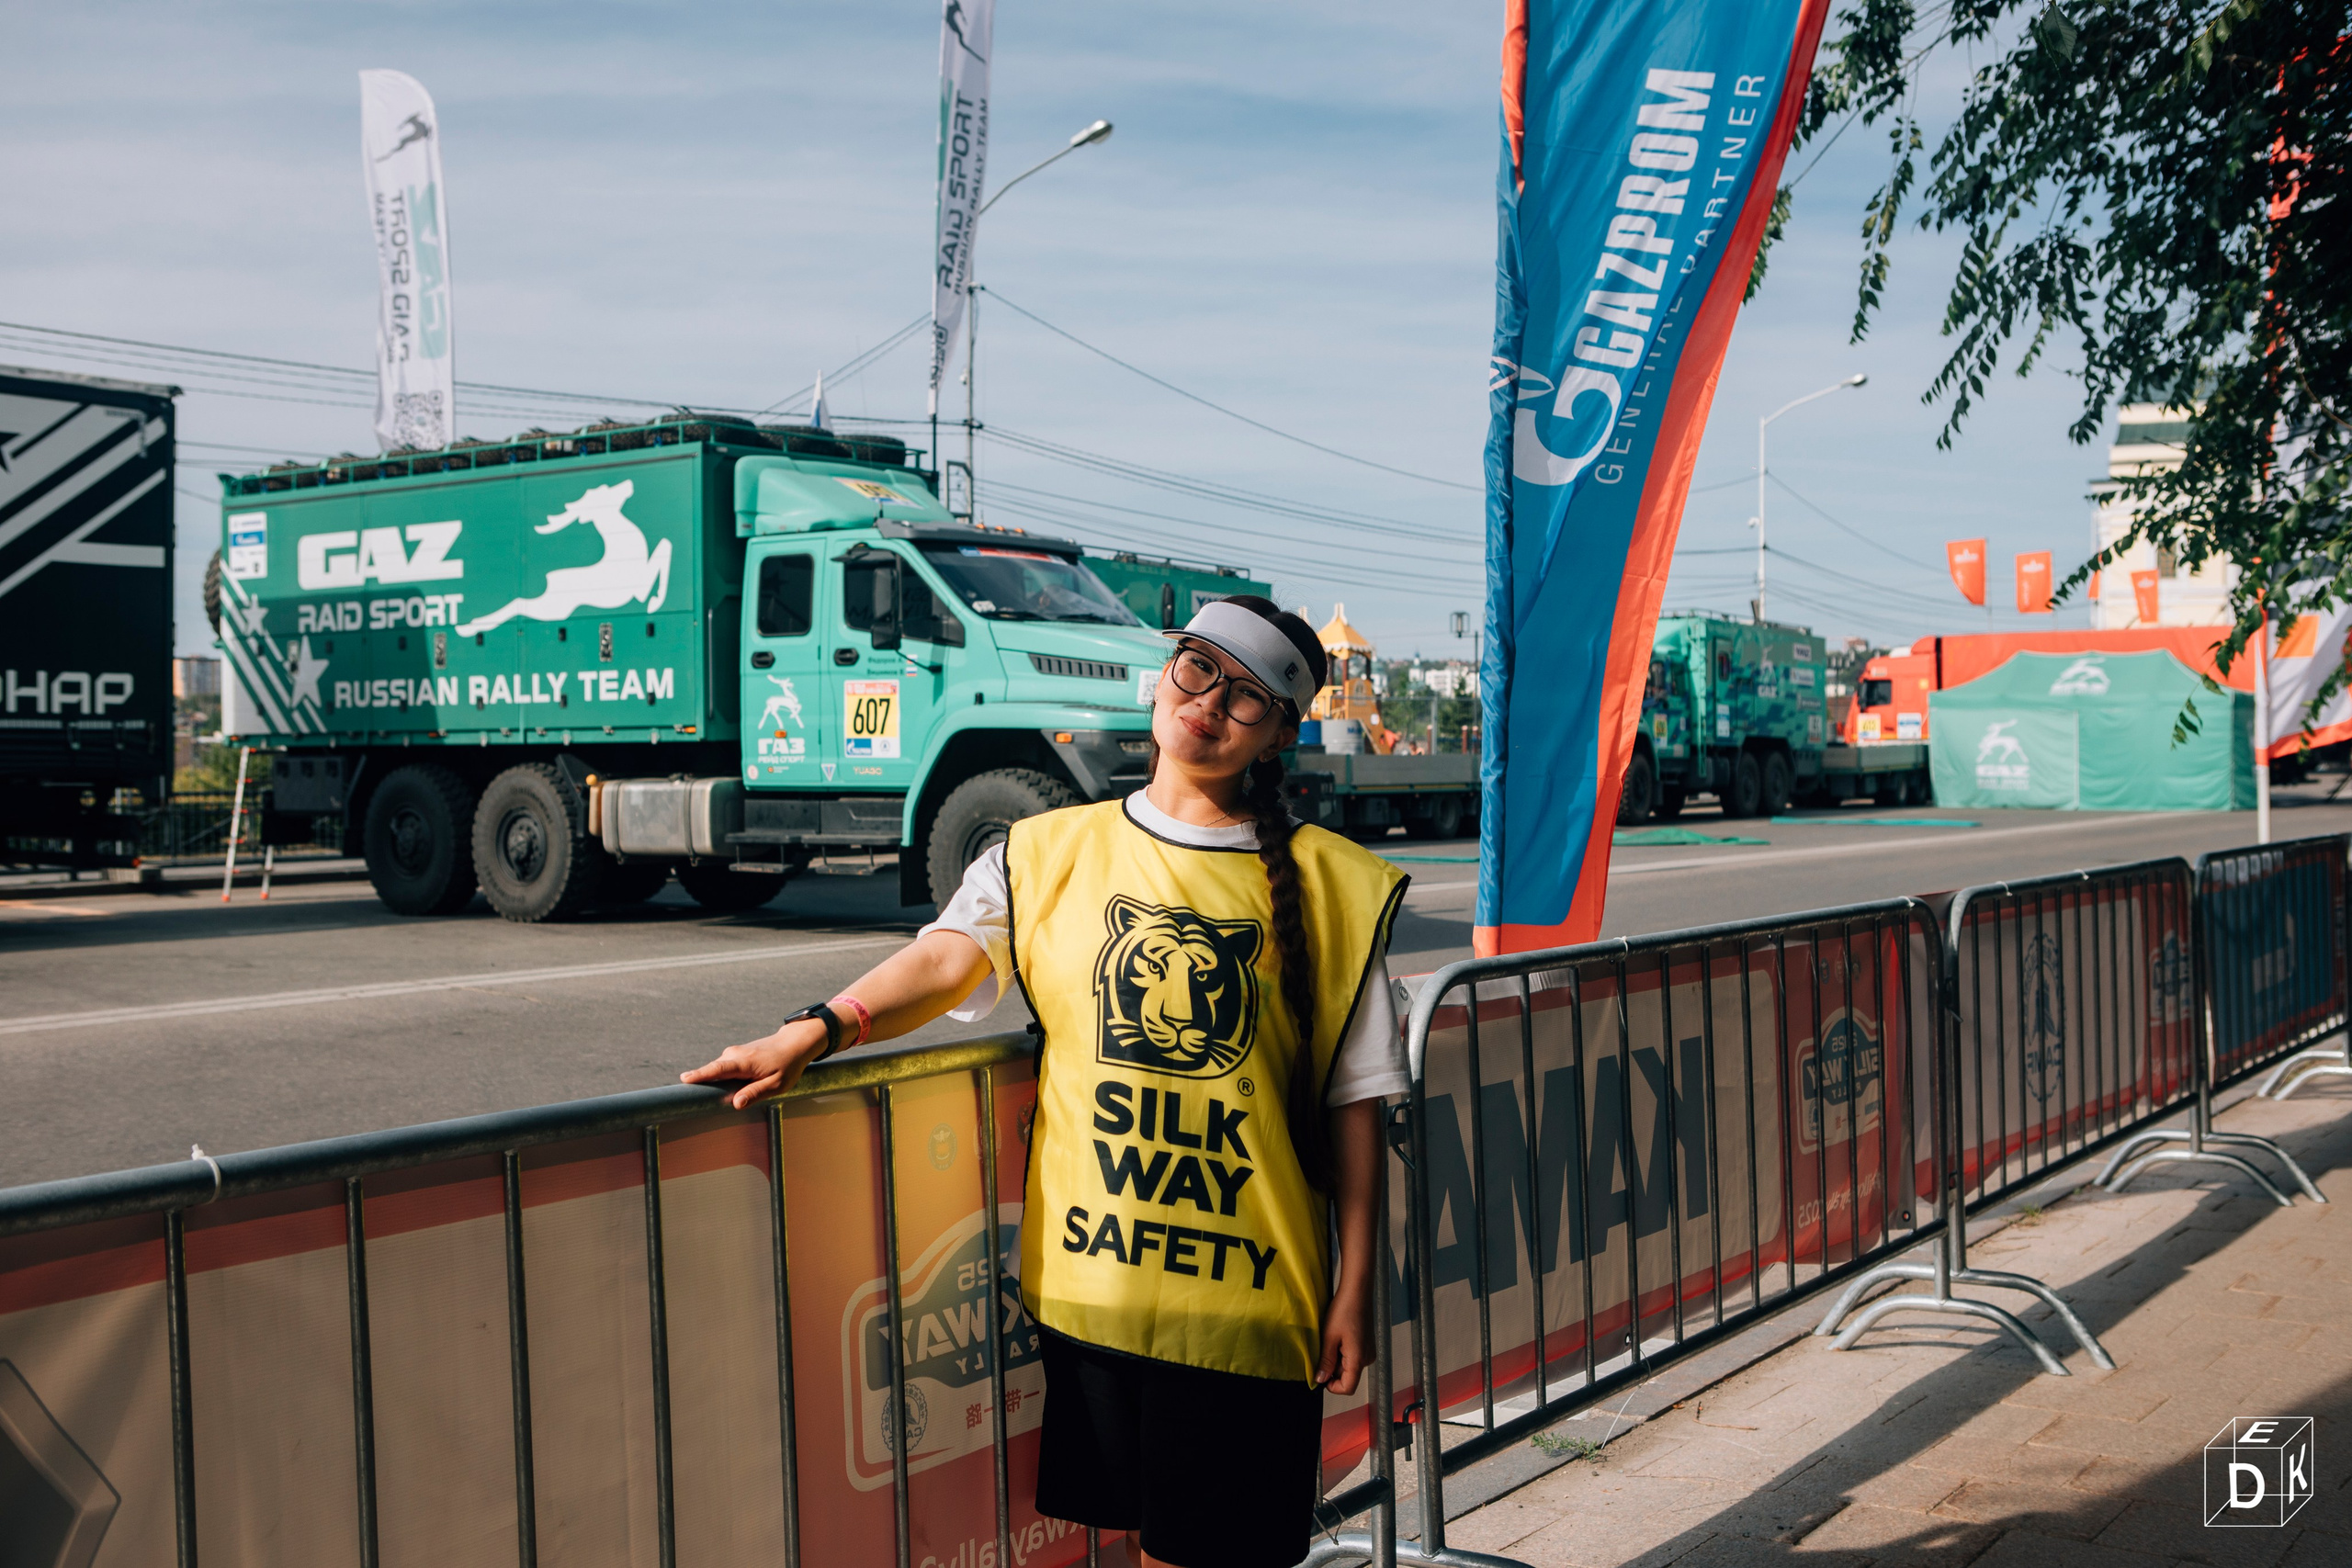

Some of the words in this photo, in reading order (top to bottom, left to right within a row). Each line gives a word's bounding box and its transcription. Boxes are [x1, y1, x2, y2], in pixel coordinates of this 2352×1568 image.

[949, 90, 975, 200] SPORT
[977, 97, 989, 149] TEAM
[937, 207, 963, 289] RAID
[1572, 68, 1716, 368] GAZPROM
[297, 519, 464, 591] GAZ
[297, 600, 363, 635] RAID
[368, 593, 464, 630] SPORT
[334, 676, 458, 708] RUSSIAN
[469, 671, 568, 705] RALLY
[578, 667, 675, 702] TEAM
[853, 698, 890, 735] 607
[758, 738, 805, 754] ГАЗ
[1093, 1080, 1252, 1161] SILK
[1093, 1139, 1255, 1218] WAY
[1063, 1205, 1279, 1292] SAFETY
